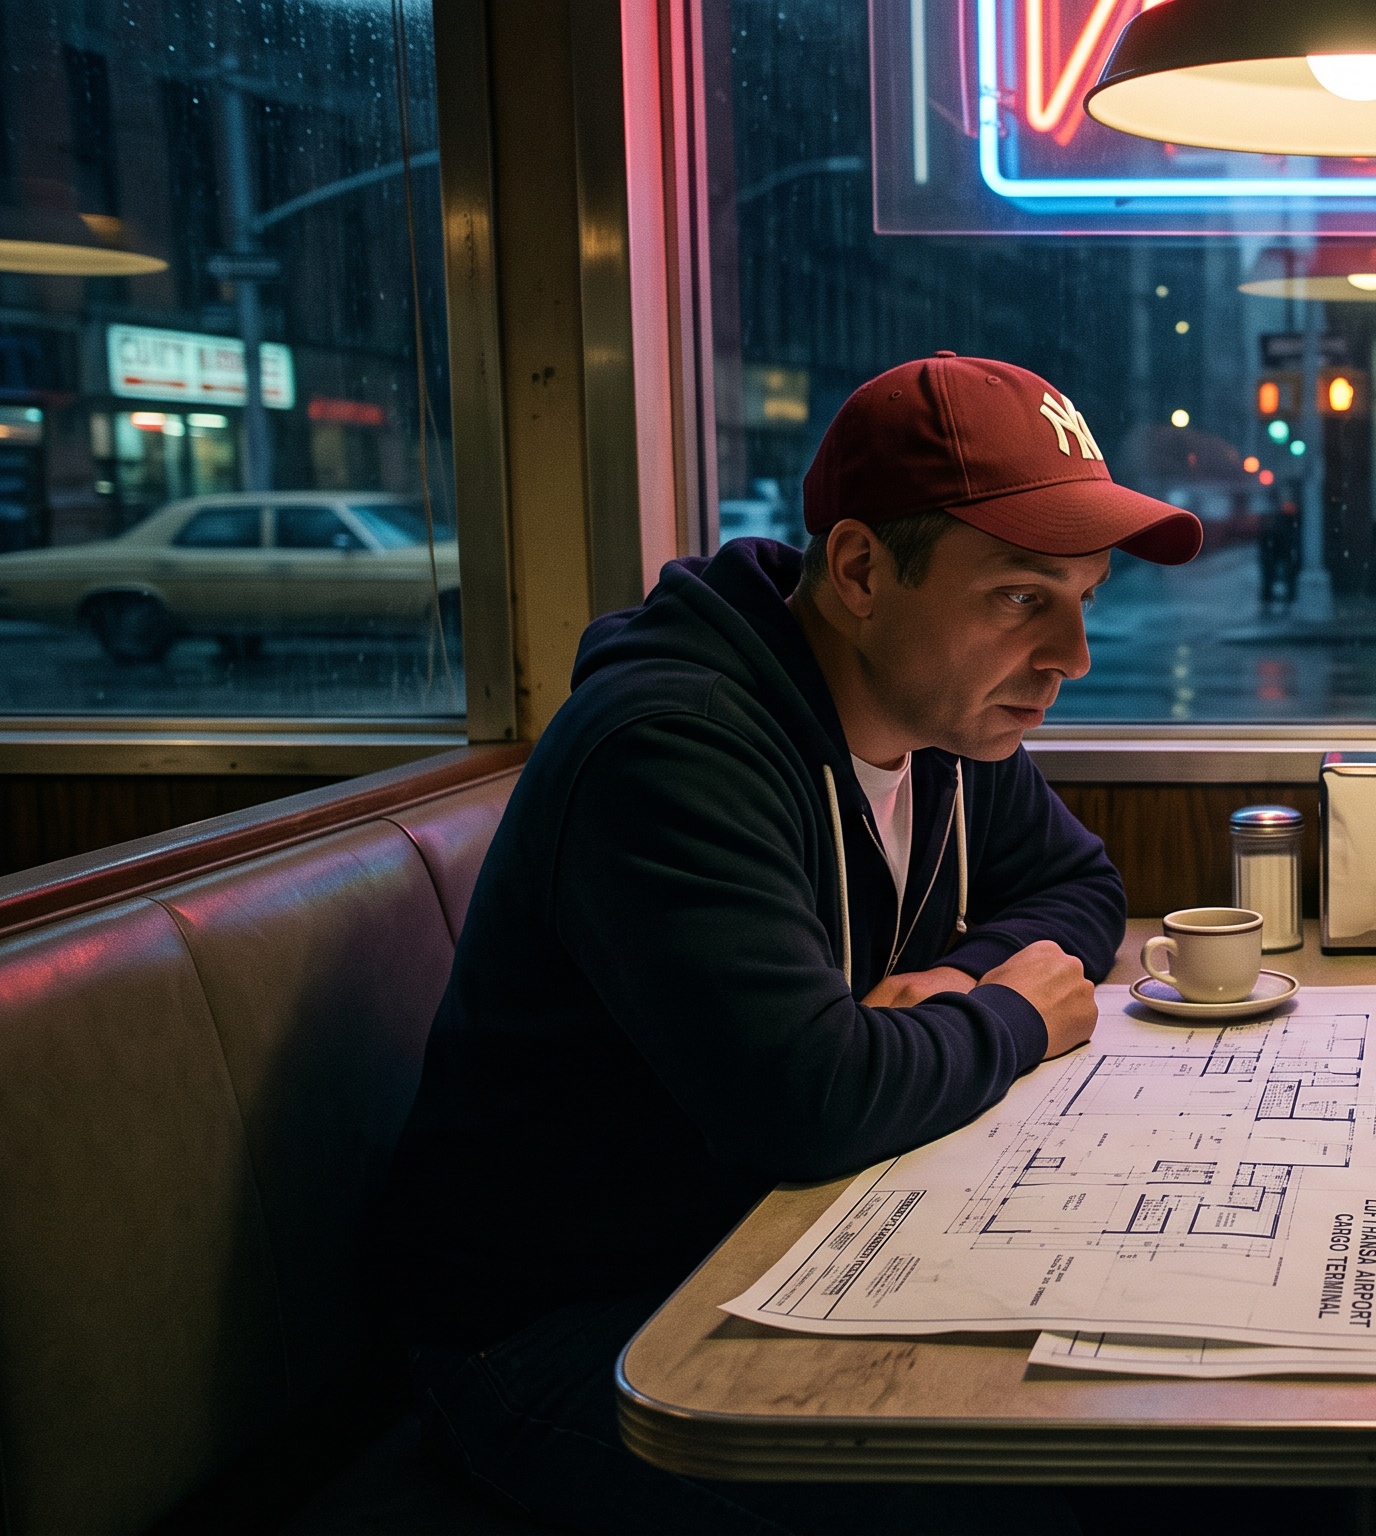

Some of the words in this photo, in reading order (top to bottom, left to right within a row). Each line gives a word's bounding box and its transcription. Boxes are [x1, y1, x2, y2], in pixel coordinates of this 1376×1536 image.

[1040, 392, 1104, 460] NY
[1329, 1213, 1354, 1252] CARGO
[1318, 1256, 1348, 1319] TERMINAL
[1349, 1270, 1376, 1328] AIRPORT
